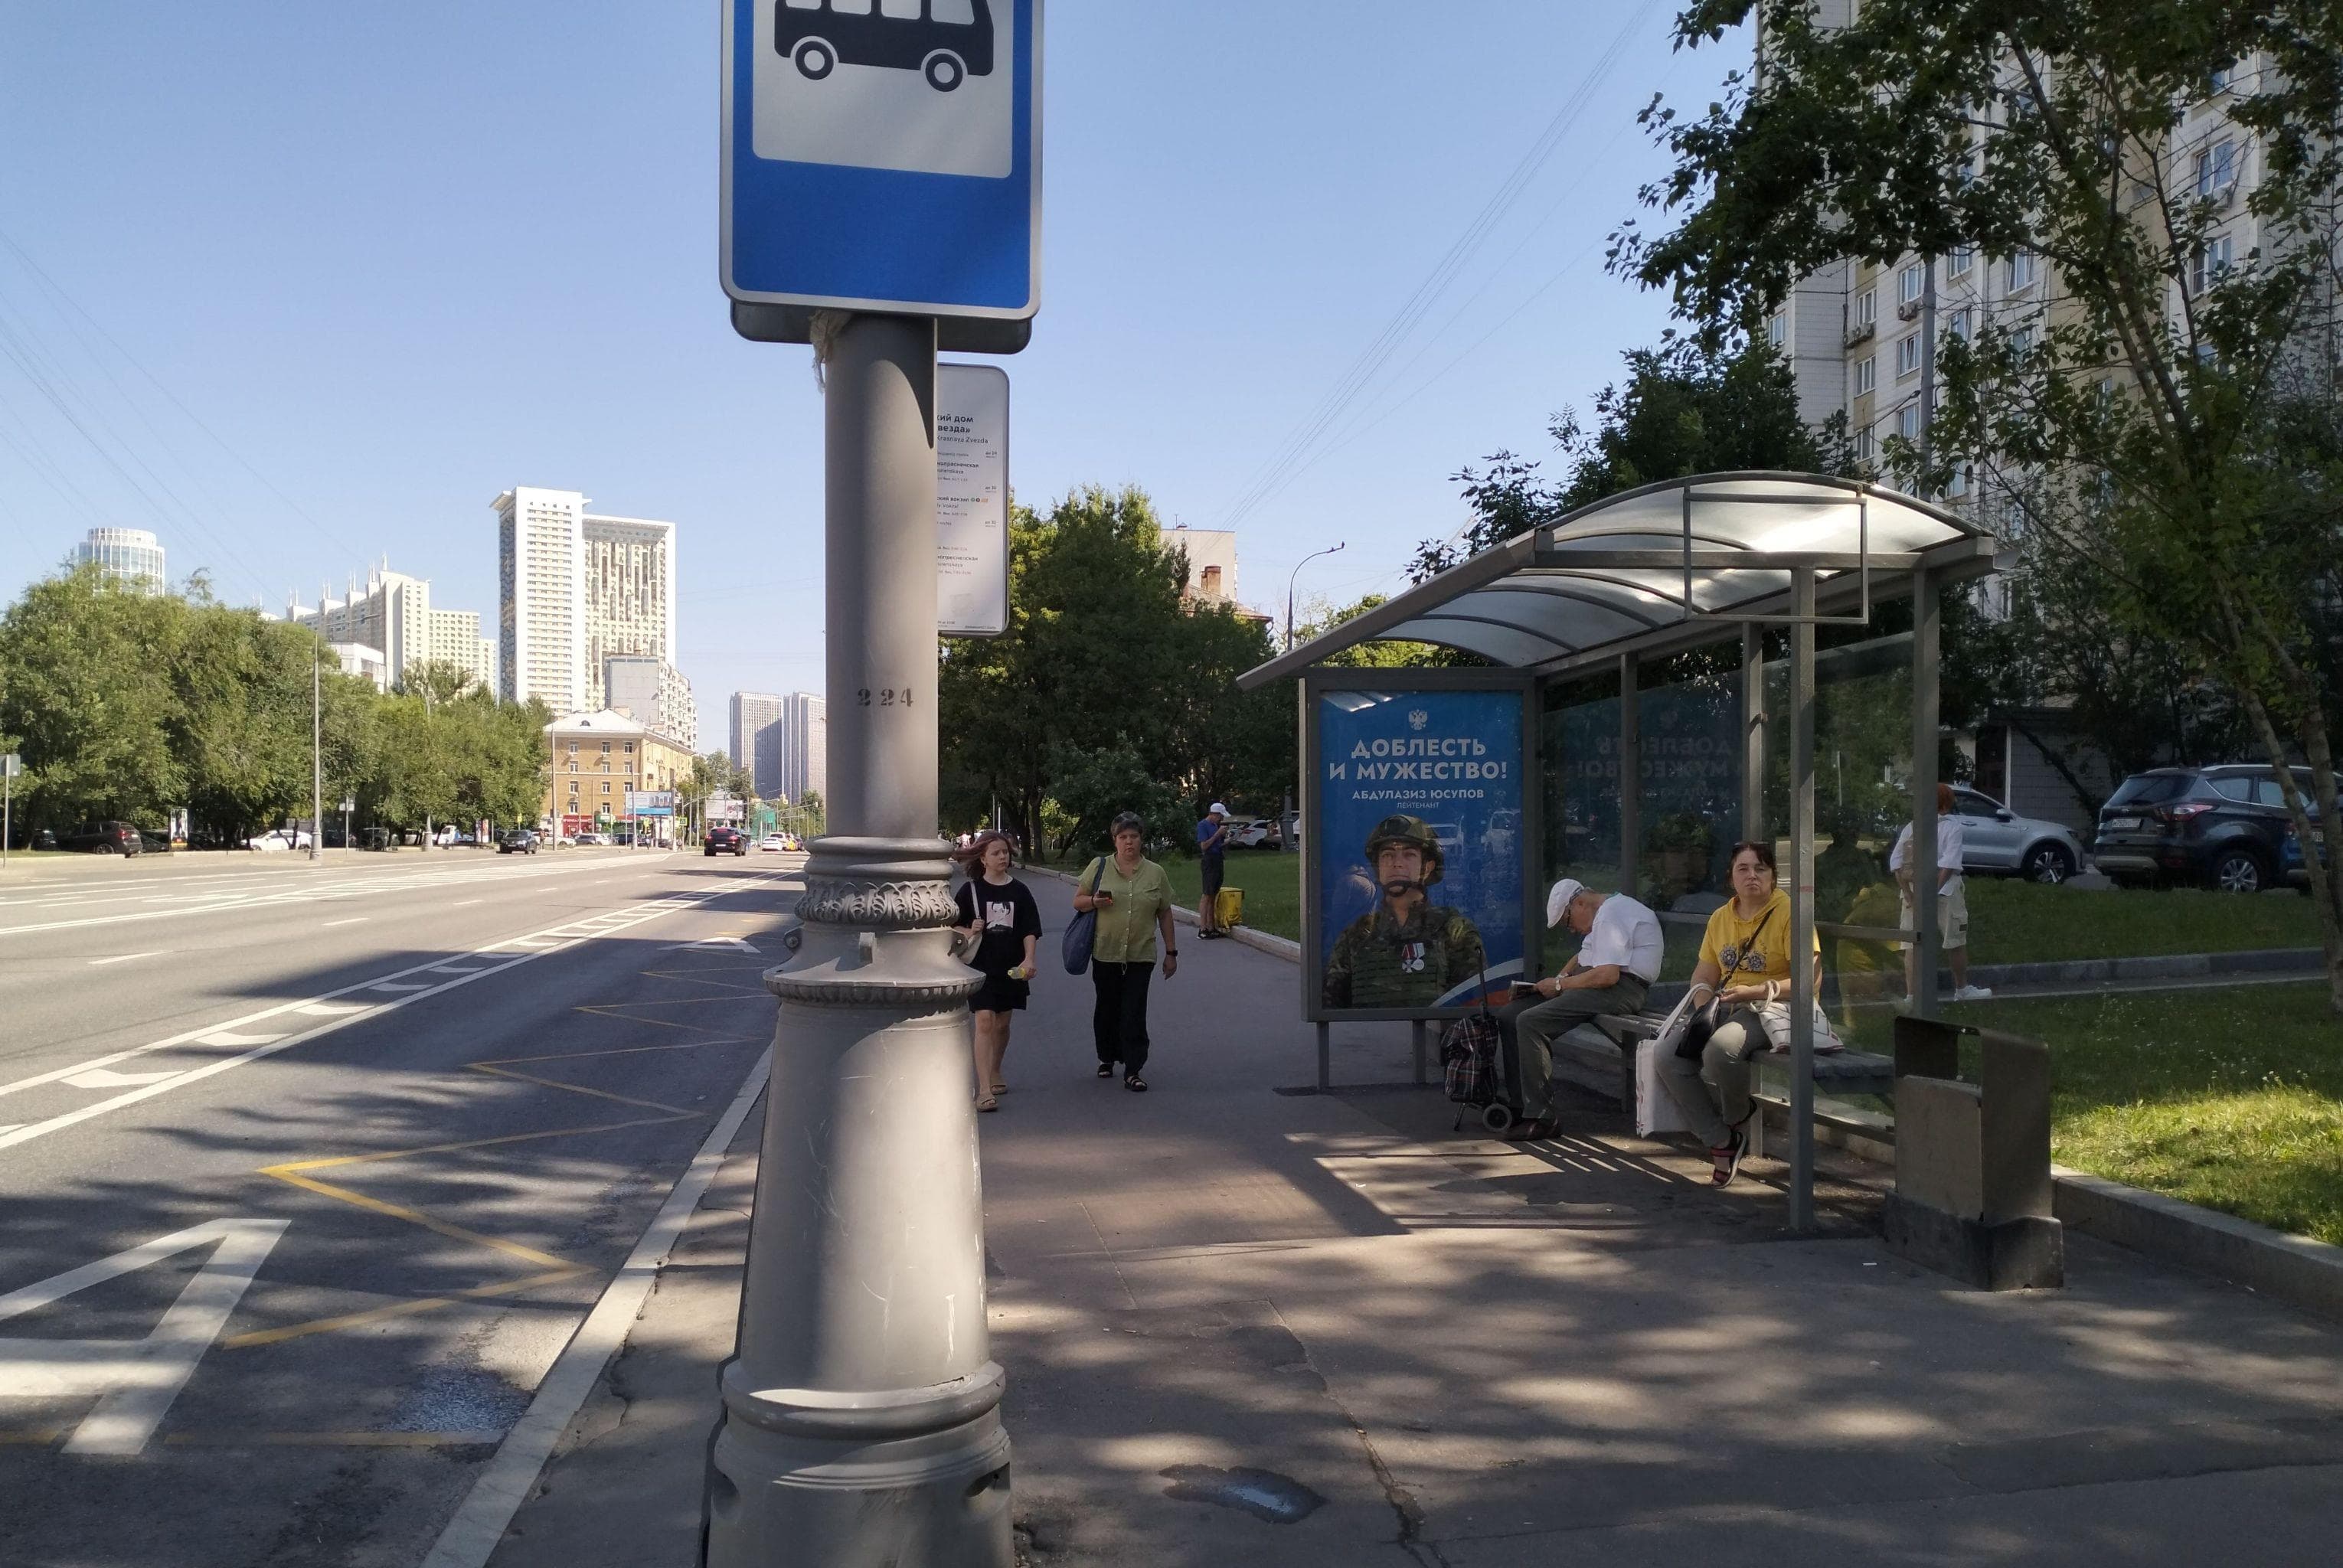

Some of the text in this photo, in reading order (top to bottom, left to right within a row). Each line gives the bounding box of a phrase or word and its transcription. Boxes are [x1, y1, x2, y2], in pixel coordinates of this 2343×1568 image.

[938, 425, 971, 434] везда»
[1351, 738, 1486, 759] ДОБЛЕСТЬ
[1329, 761, 1508, 780] И МУЖЕСТВО!
[1352, 789, 1485, 801] АБДУЛАЗИЗ ЮСУПОВ
